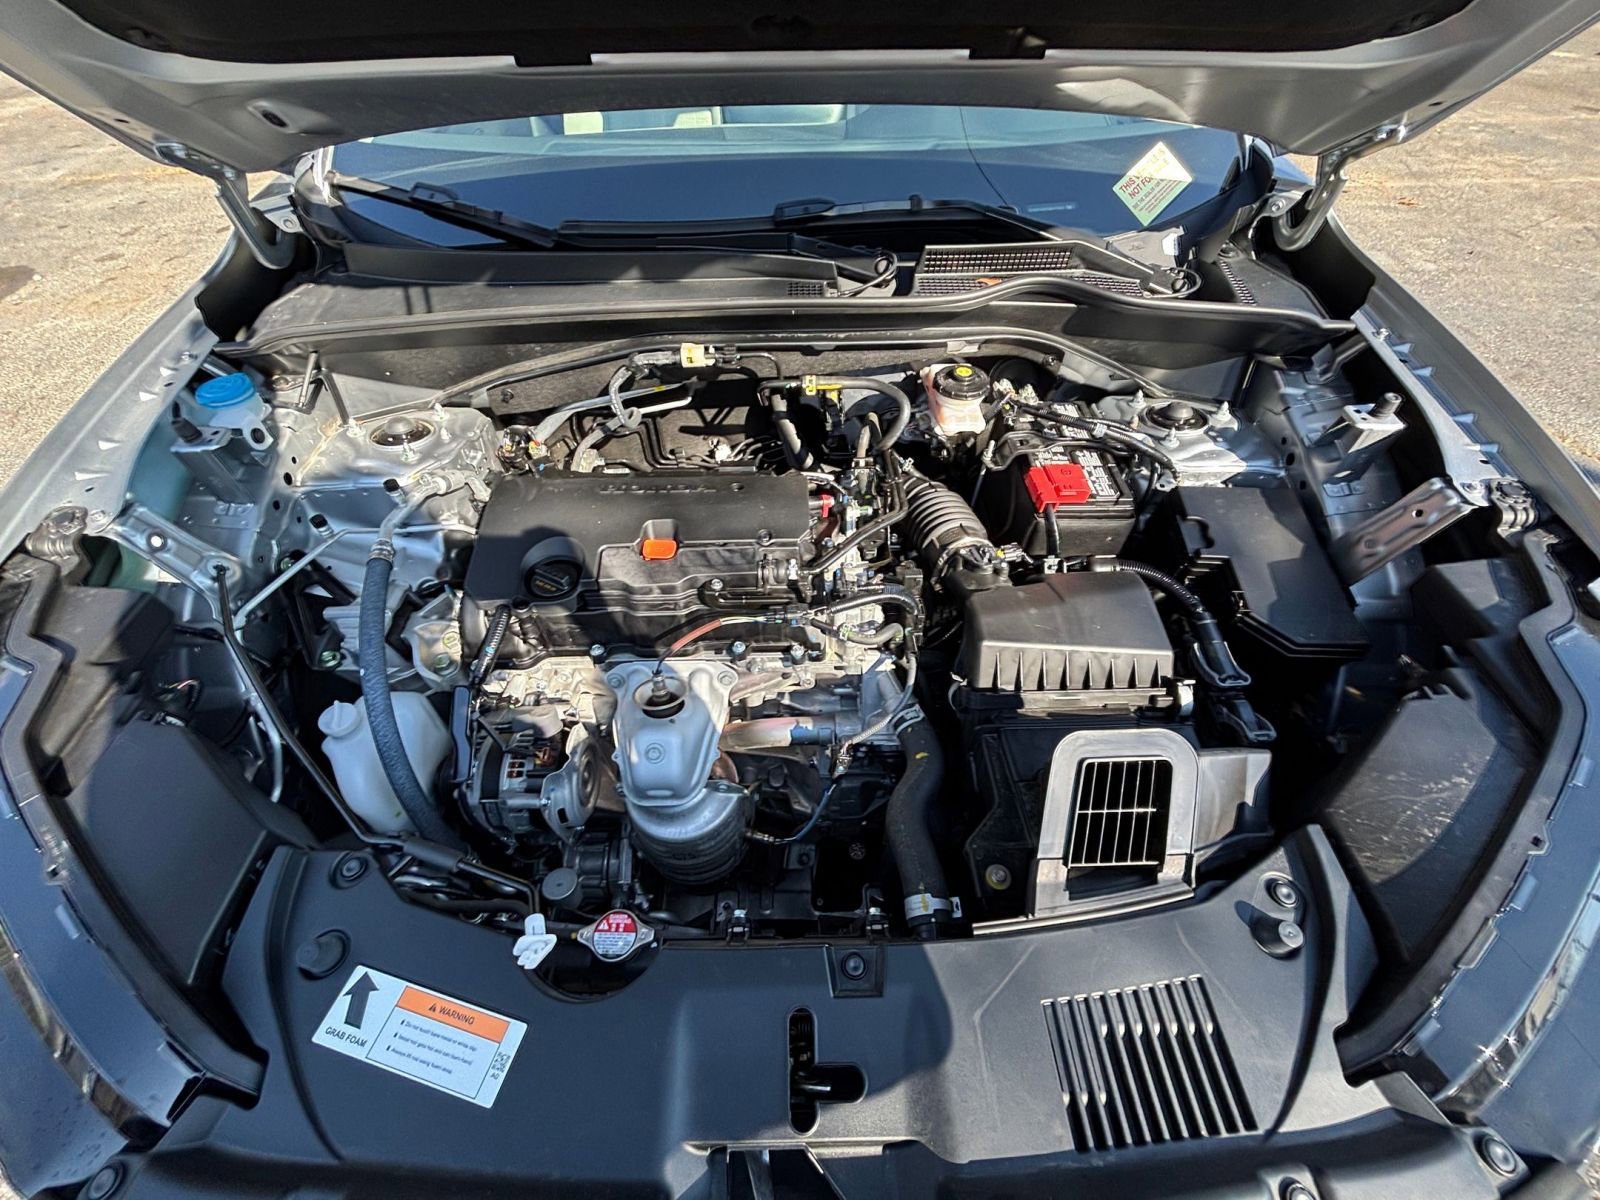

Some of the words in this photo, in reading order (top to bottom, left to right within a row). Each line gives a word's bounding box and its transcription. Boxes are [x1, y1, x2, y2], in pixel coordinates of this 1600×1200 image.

[1119, 176, 1136, 193] THIS
[1128, 184, 1143, 199] NOT
[325, 1026, 347, 1040] GRAB
[345, 1033, 367, 1047] FOAM
